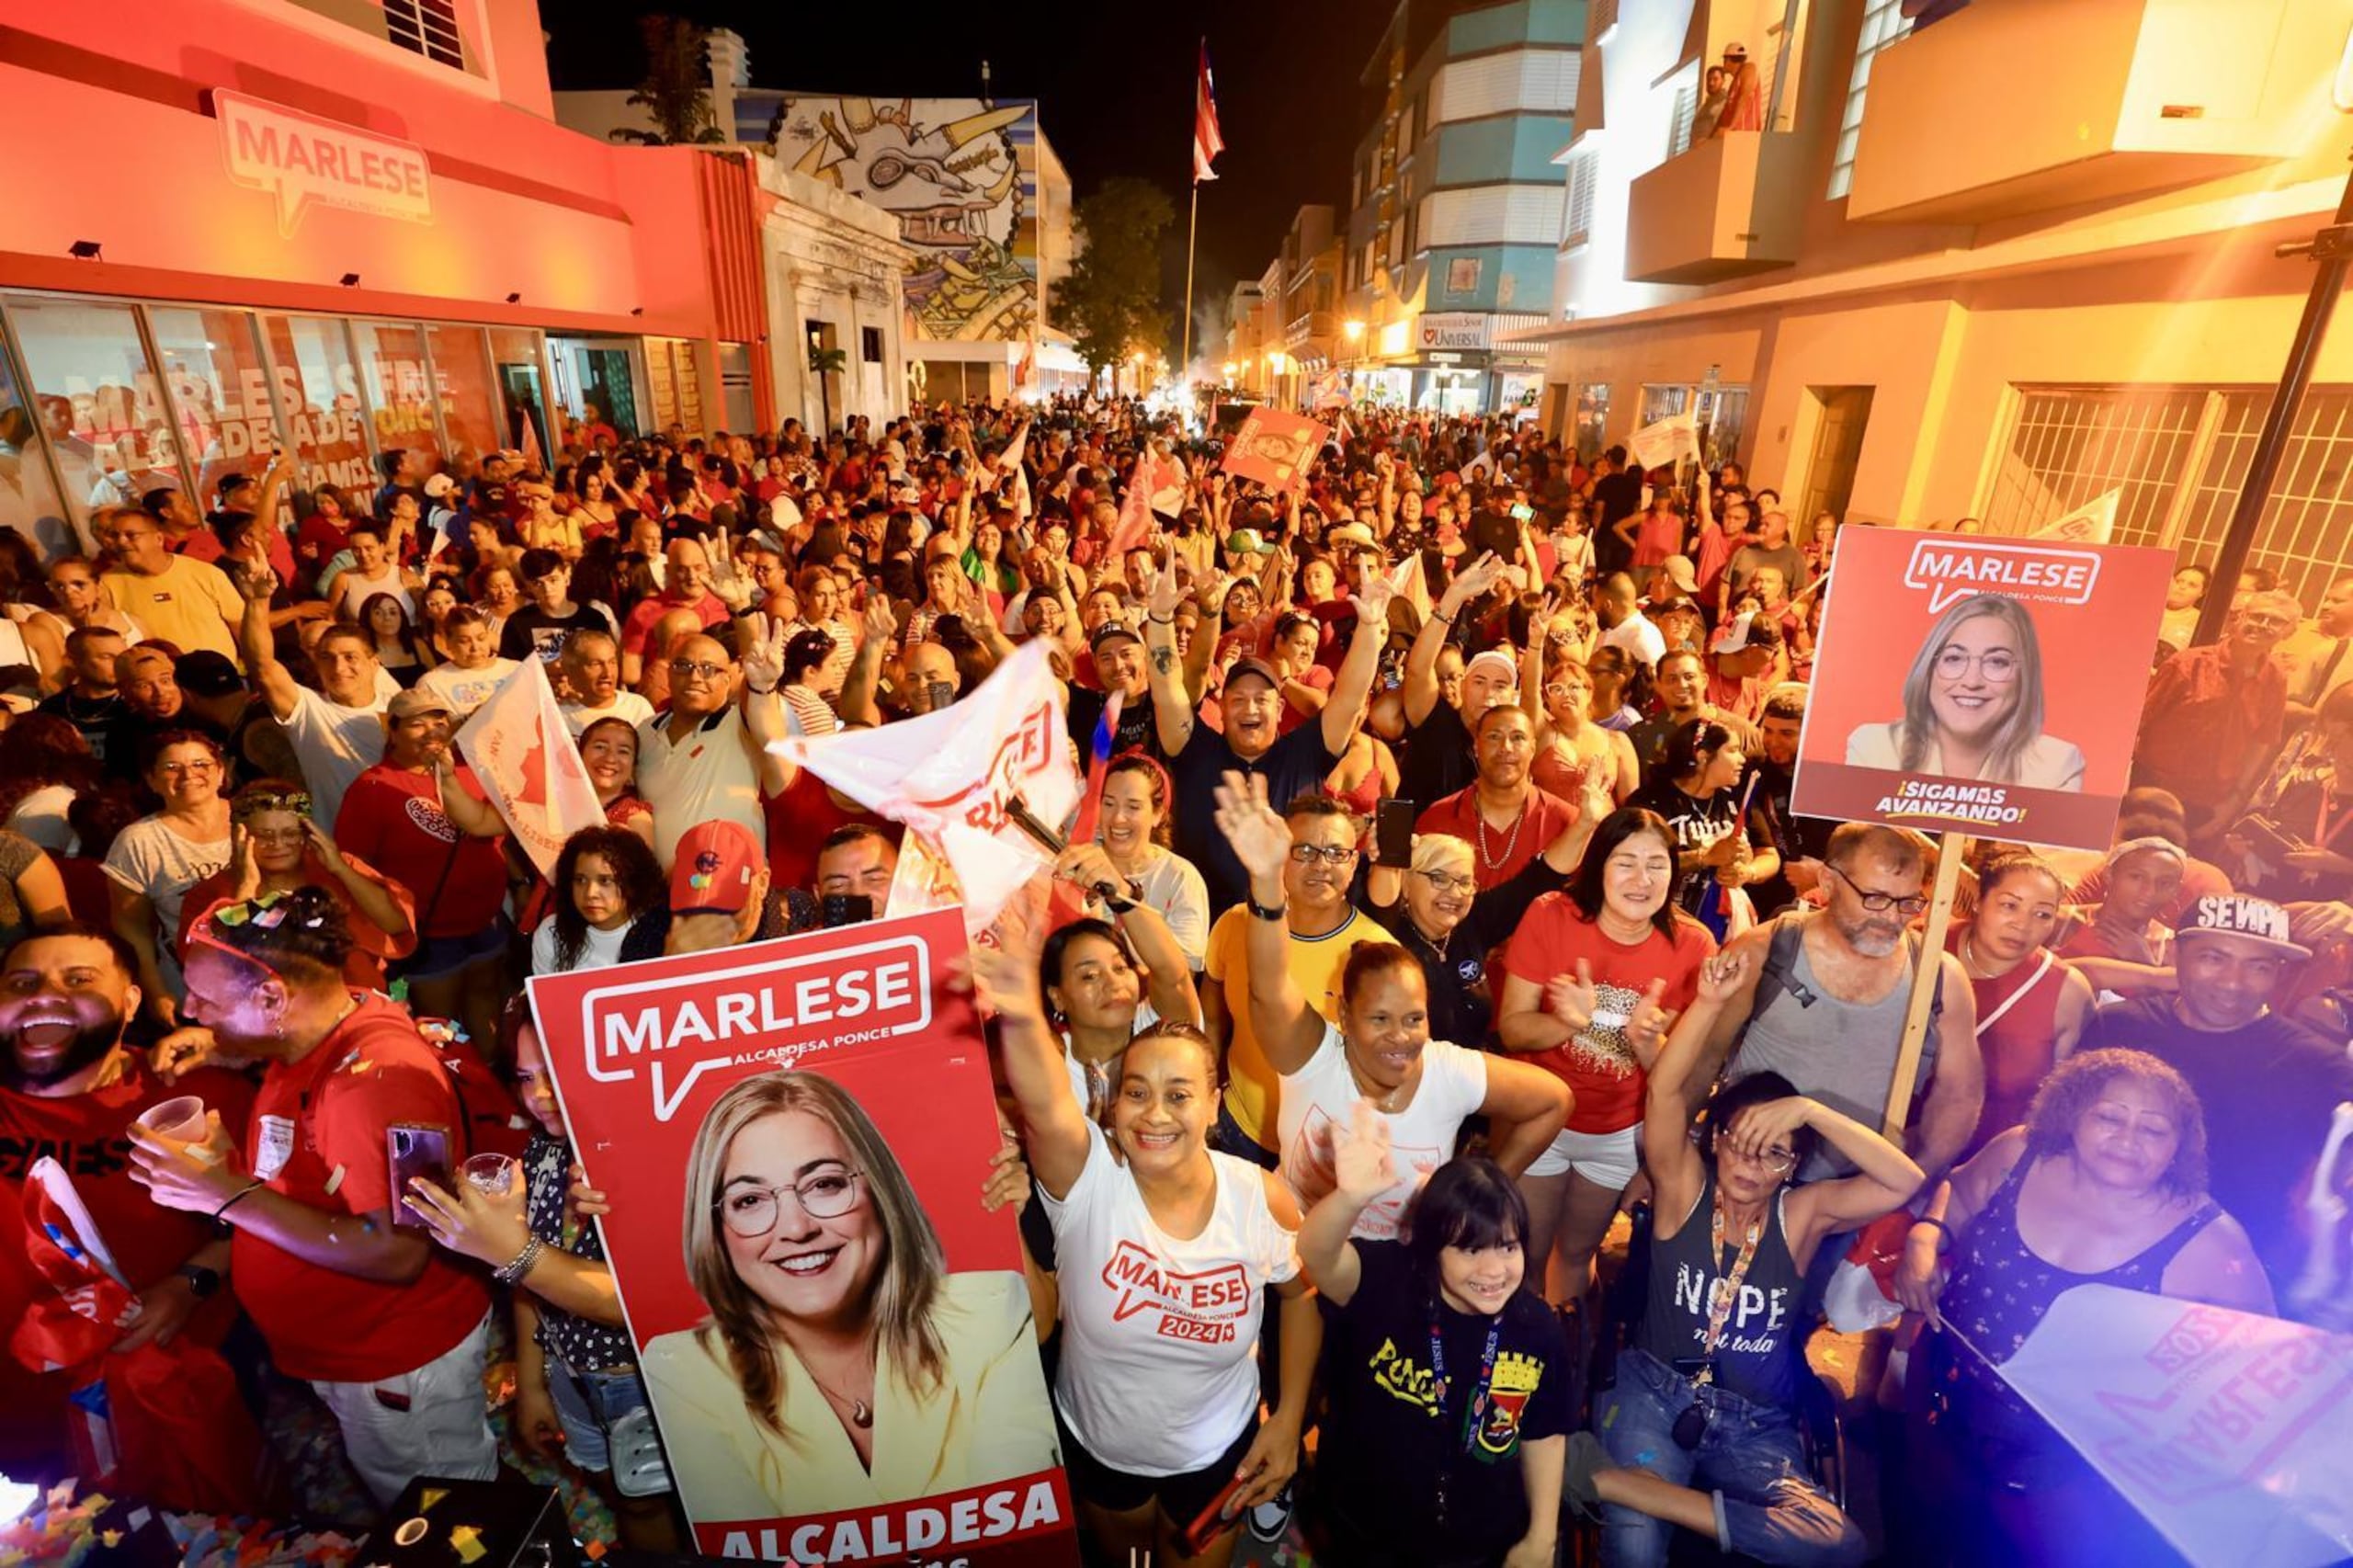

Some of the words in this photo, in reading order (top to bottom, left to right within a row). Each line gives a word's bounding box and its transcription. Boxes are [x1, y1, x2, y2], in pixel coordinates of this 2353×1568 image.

[234, 118, 425, 199] MARLESE
[1435, 329, 1481, 347] UNIVERSAL
[1917, 552, 2087, 590] MARLESE
[1875, 797, 2028, 824] AVANZANDO!
[604, 960, 913, 1058] MARLESE
[833, 1027, 891, 1048] PONCE
[1115, 1255, 1243, 1310] MARESE
[1163, 1318, 1218, 1341] 2024
[1693, 1327, 1729, 1349] nt
[1431, 1337, 1443, 1371] JESUS
[1483, 1331, 1499, 1366] JESUS
[722, 1482, 1061, 1564] ALCALDESA
